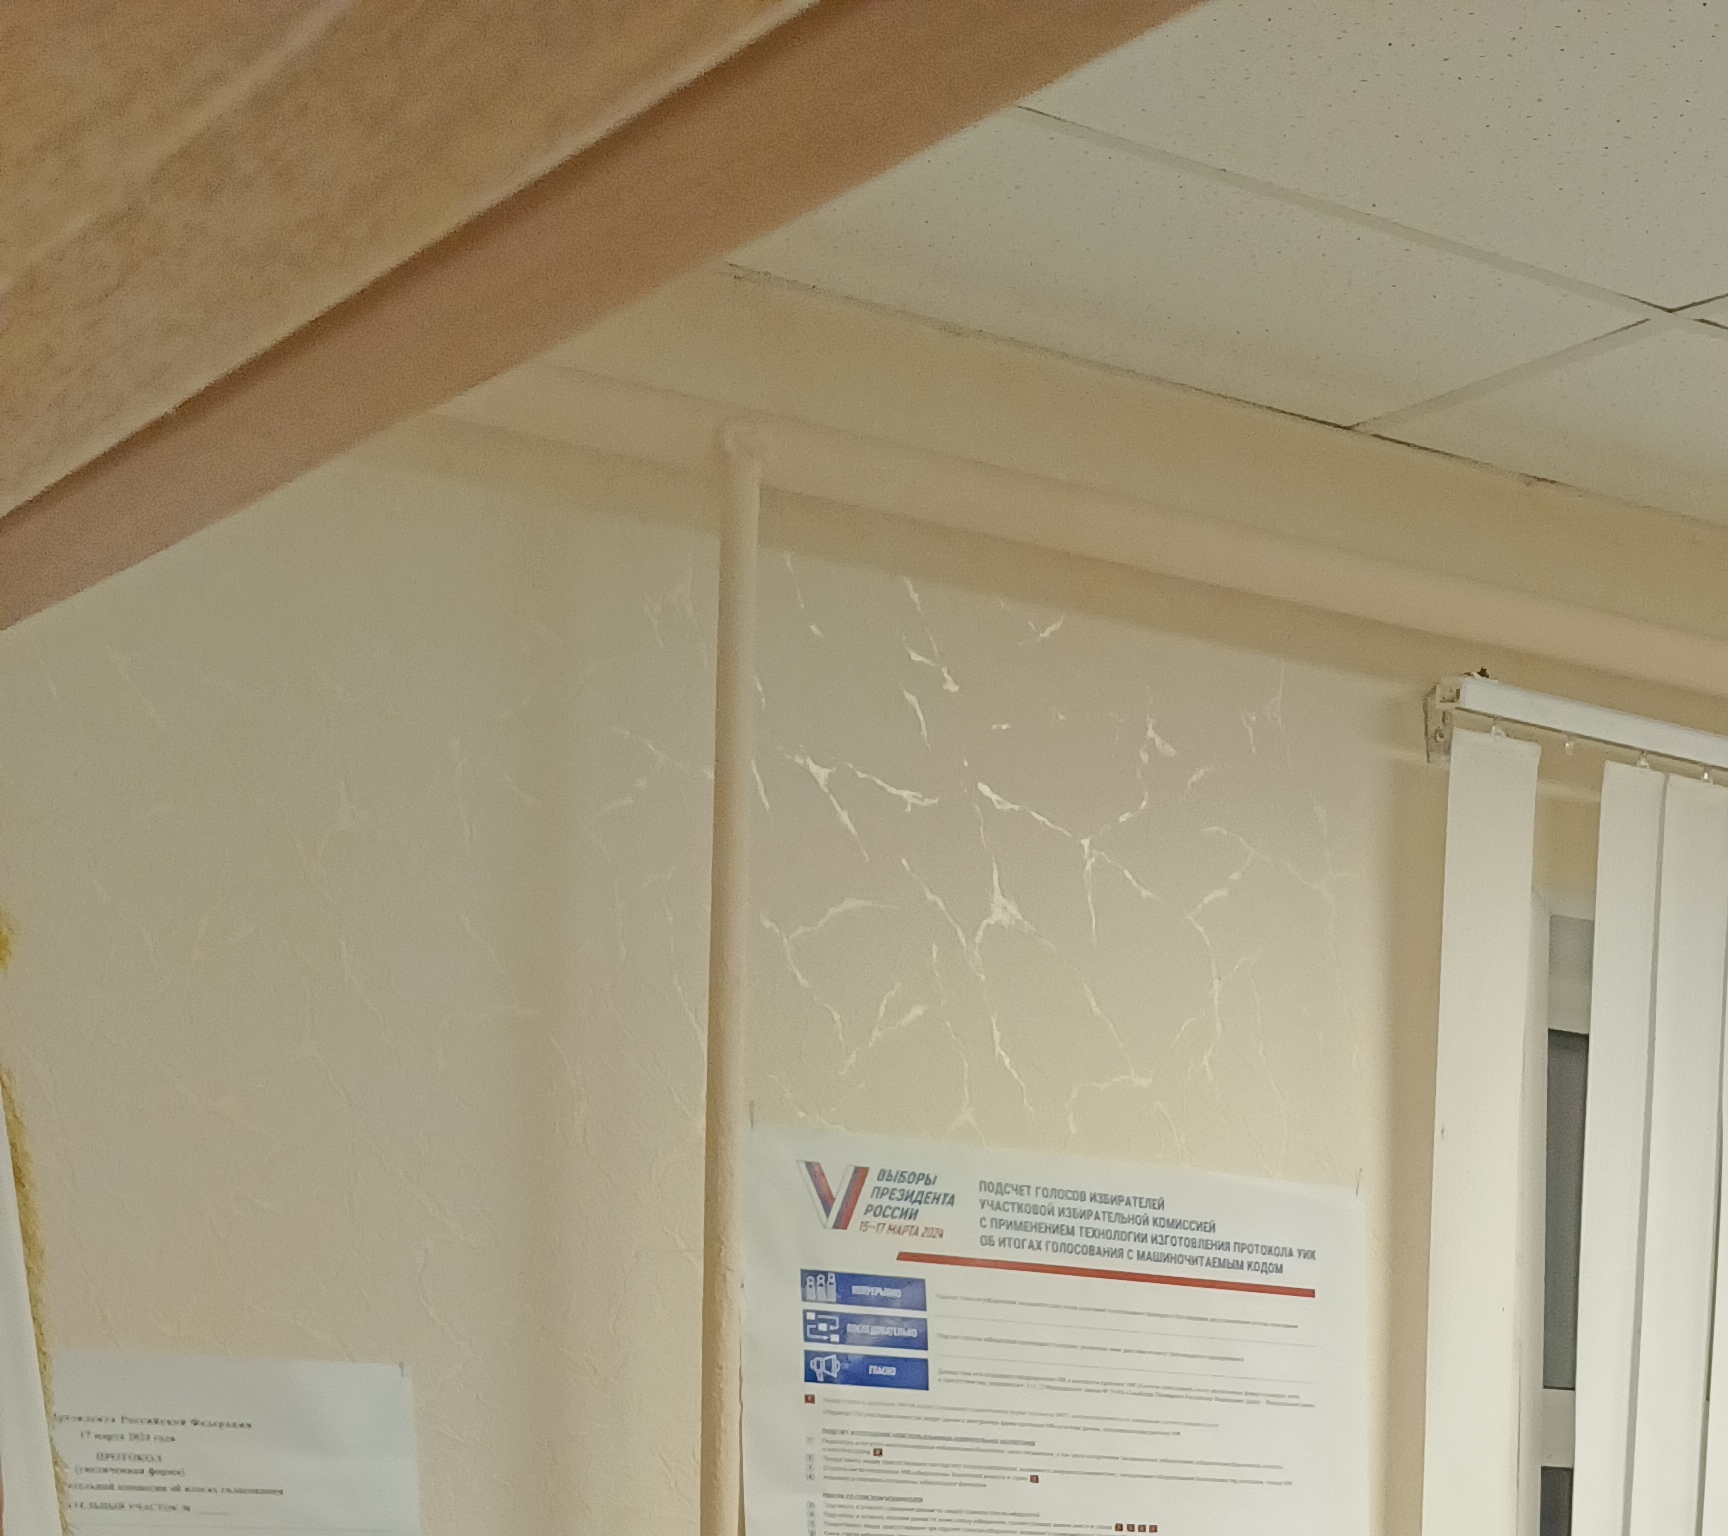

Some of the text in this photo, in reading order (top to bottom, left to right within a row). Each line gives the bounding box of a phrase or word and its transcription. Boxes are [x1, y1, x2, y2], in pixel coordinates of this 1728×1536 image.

[877, 1168, 937, 1186] ВЫБОРЫ
[870, 1186, 955, 1207] ПРЕЗИДЕНТА
[979, 1180, 1165, 1211] ПОДСЧЕТ ГОЛОСОВ ИЗБИРАТЕЛЕЙ
[863, 1203, 919, 1221] РОССИИ
[979, 1199, 1216, 1234] УЧАСТКОВОЙ ИЗБИРАТЕЛЬНОЙ КОМИССИЕЙ
[887, 1223, 919, 1237] МАРТА
[921, 1226, 944, 1239] 2024
[980, 1217, 1316, 1260] С ПРИМЕНЕНИЕМ ТЕХНОЛОГИИ ИЗГОТОВЛЕНИЯ ПРОТОКОЛА УИК
[980, 1235, 1284, 1275] ОБ ИТОГАХ ГОЛОСОВАНИЯ С МАШИНОЧИТАЕМЫМ КОДОМ
